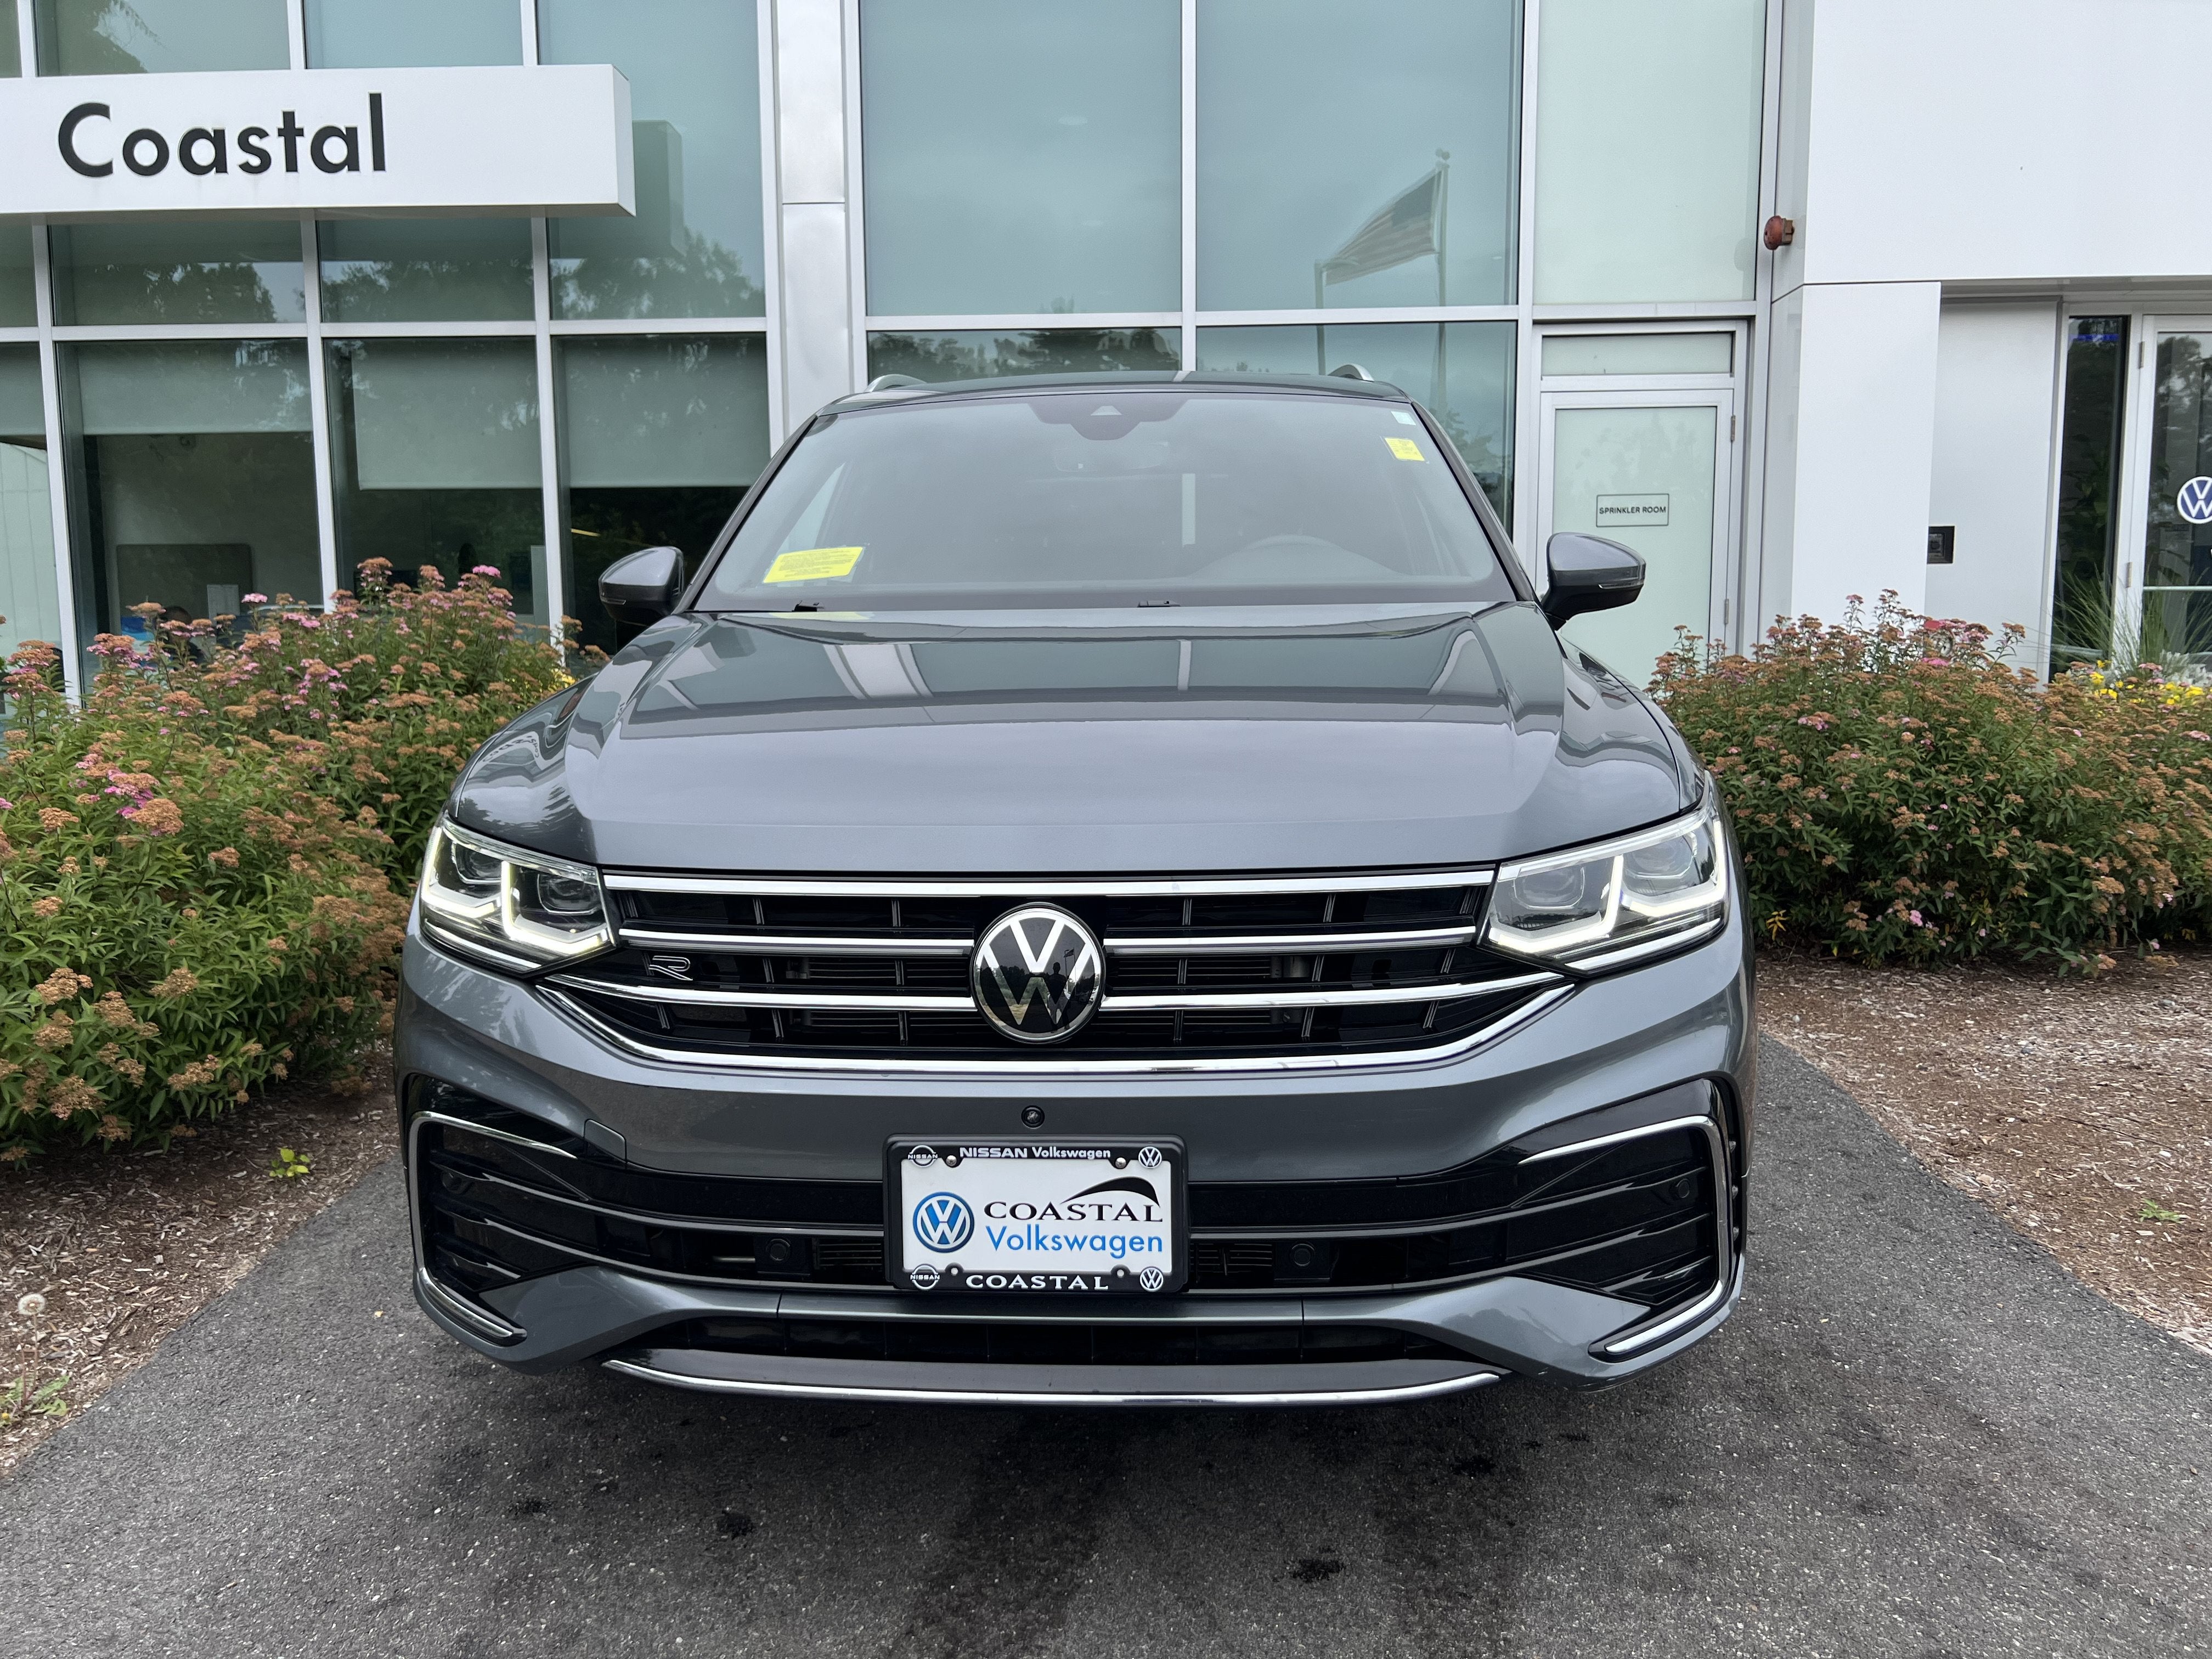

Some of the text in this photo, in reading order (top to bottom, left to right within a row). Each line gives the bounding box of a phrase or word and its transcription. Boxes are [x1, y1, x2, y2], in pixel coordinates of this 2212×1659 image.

[58, 92, 386, 178] Coastal
[2179, 477, 2212, 520] VW
[648, 955, 693, 981] R
[977, 912, 1099, 1030] VW
[960, 1146, 1111, 1159] NISSAN Volkswagen
[1139, 1147, 1161, 1167] VW
[917, 1195, 970, 1249] VW
[984, 1201, 1163, 1223] COASTAL
[985, 1224, 1163, 1259] Volkswagen
[966, 1274, 1109, 1290] COASTAL
[1141, 1268, 1163, 1290] VW
